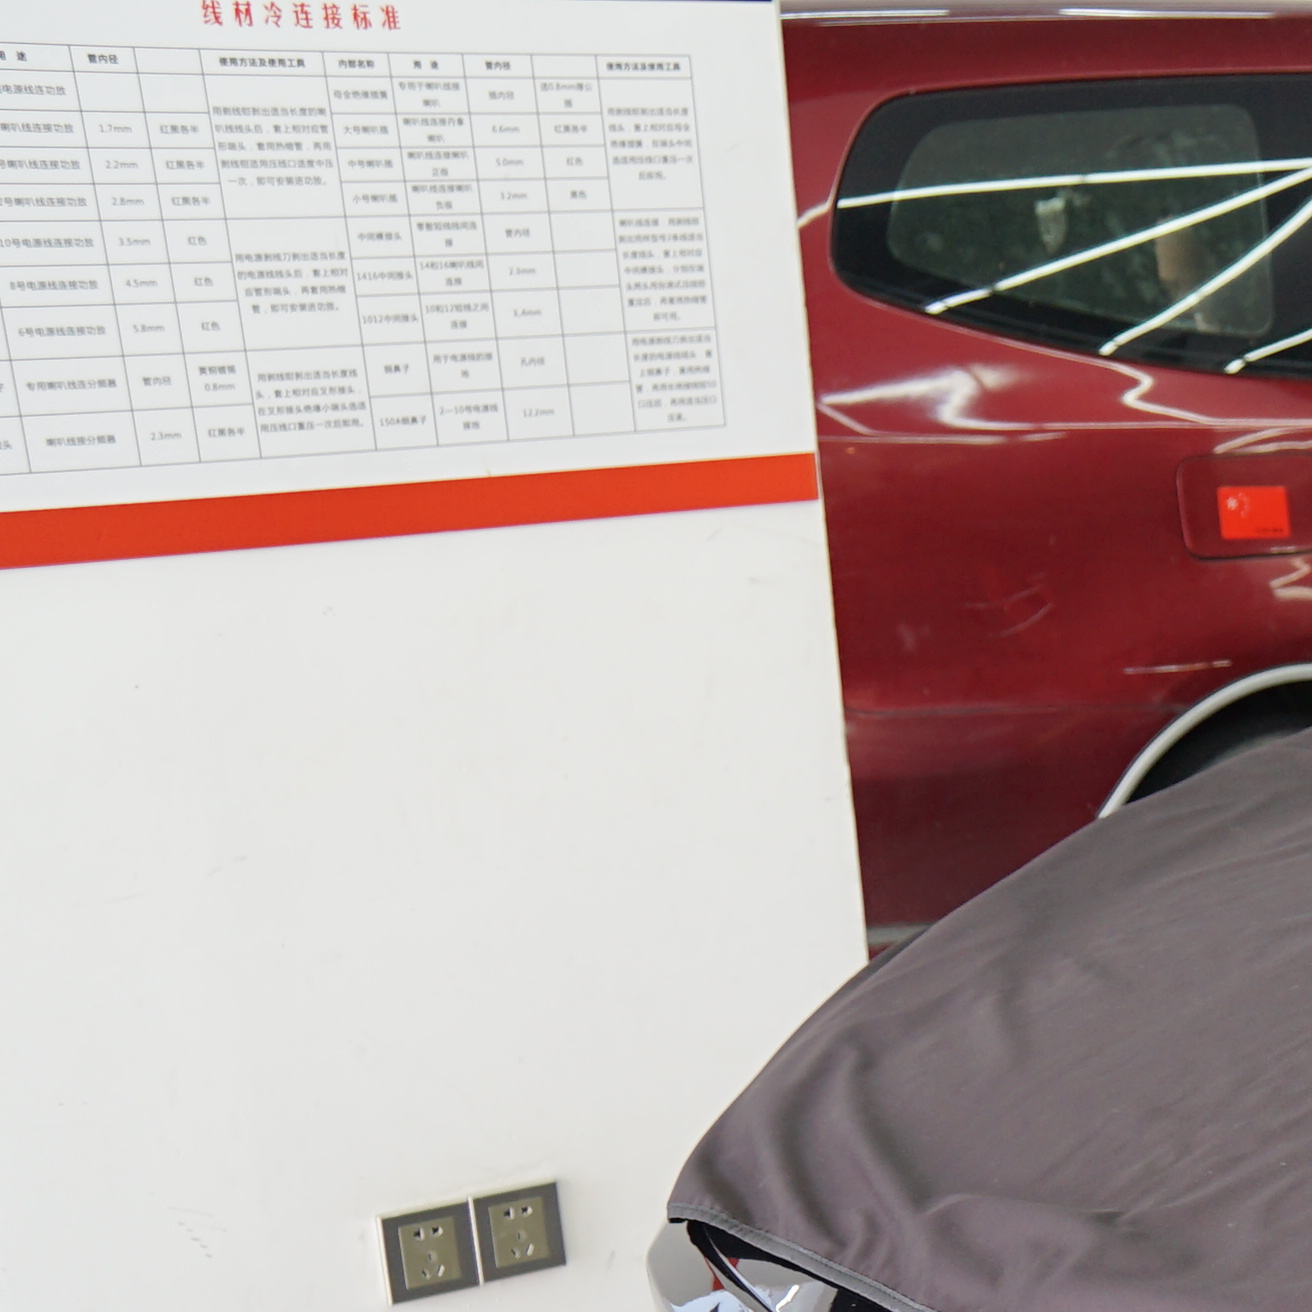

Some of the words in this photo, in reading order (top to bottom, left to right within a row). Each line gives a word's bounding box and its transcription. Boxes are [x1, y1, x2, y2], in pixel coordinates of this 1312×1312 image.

[202, 1, 401, 30] 线材冷连接标准
[0, 83, 67, 95] 电源线连功放
[98, 124, 133, 134] 1.7mm
[105, 160, 139, 170] 2.2mm
